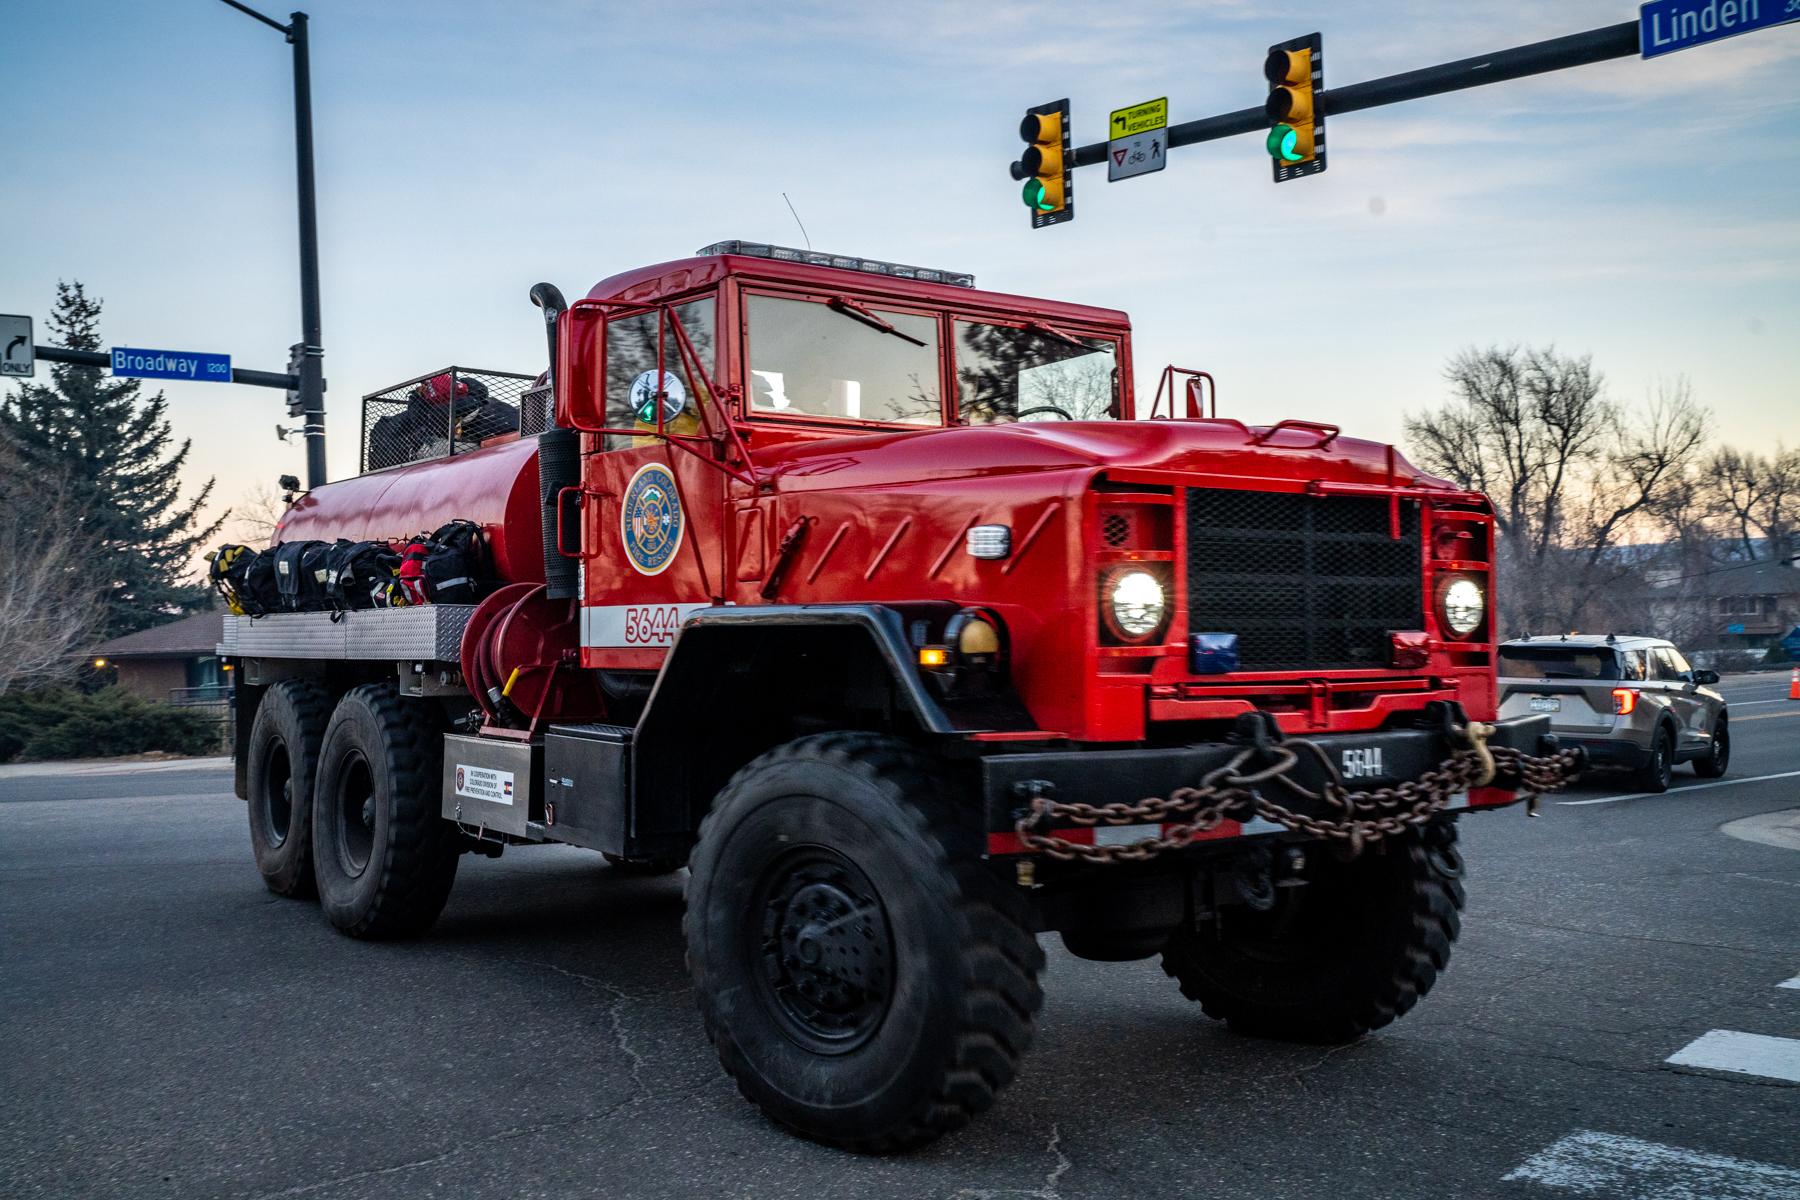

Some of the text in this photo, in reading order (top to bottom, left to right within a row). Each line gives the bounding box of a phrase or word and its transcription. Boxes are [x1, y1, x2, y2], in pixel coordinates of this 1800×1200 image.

[1653, 0, 1759, 46] Linden
[1127, 116, 1165, 131] VEHICLES
[1128, 104, 1162, 119] TURNING
[3, 362, 31, 373] ONLY
[115, 350, 227, 377] Broadway 1200
[656, 474, 680, 528] COLORADO
[625, 607, 682, 643] 5644
[1342, 747, 1382, 778] 5644
